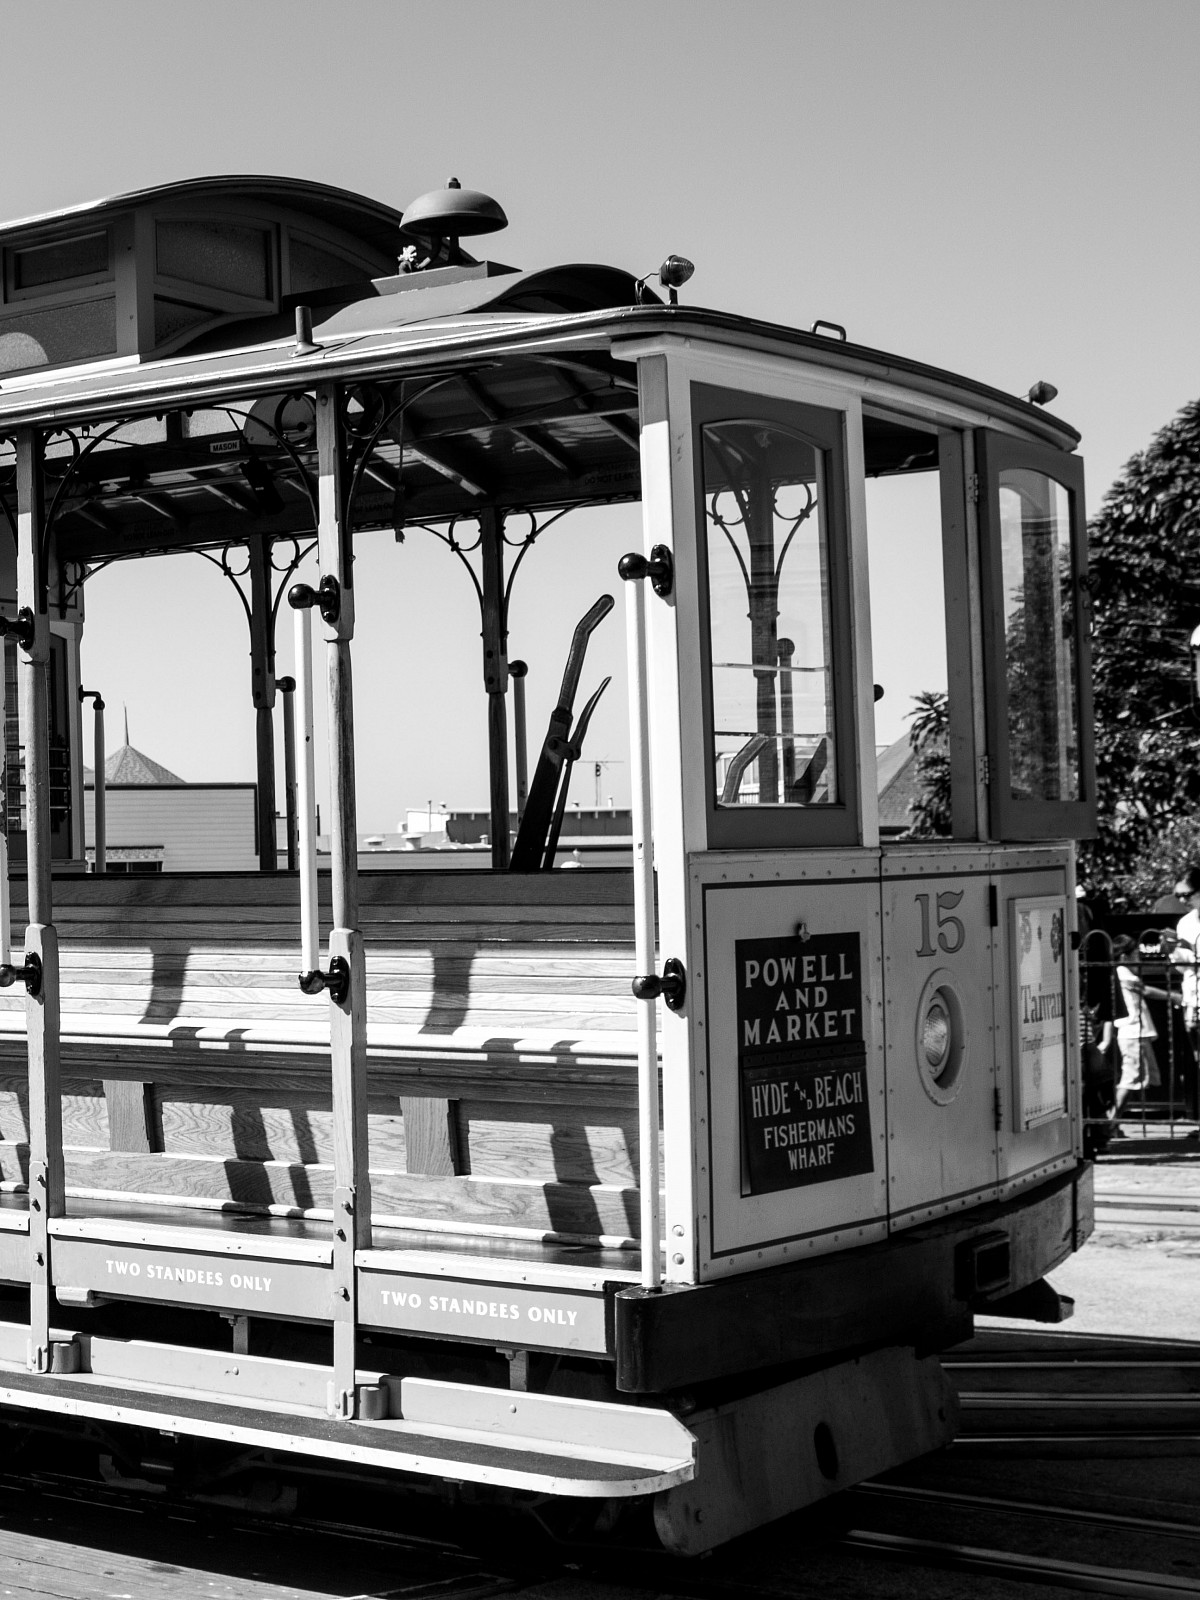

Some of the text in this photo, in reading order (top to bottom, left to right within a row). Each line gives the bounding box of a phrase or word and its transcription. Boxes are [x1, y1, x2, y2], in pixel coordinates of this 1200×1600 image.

[213, 442, 238, 452] MASON
[914, 889, 966, 957] 15
[745, 953, 853, 988] POWELL
[775, 986, 828, 1012] AND
[1020, 982, 1062, 1024] Taiwan
[744, 1008, 856, 1047] MARKET
[751, 1071, 863, 1118] HYDE AND BEACH
[763, 1114, 856, 1149] FISHERMANS
[788, 1142, 835, 1171] WHARF
[105, 1259, 272, 1292] TWO STANDEES ONLY
[380, 1290, 578, 1326] TWO STANDEES ONLY
